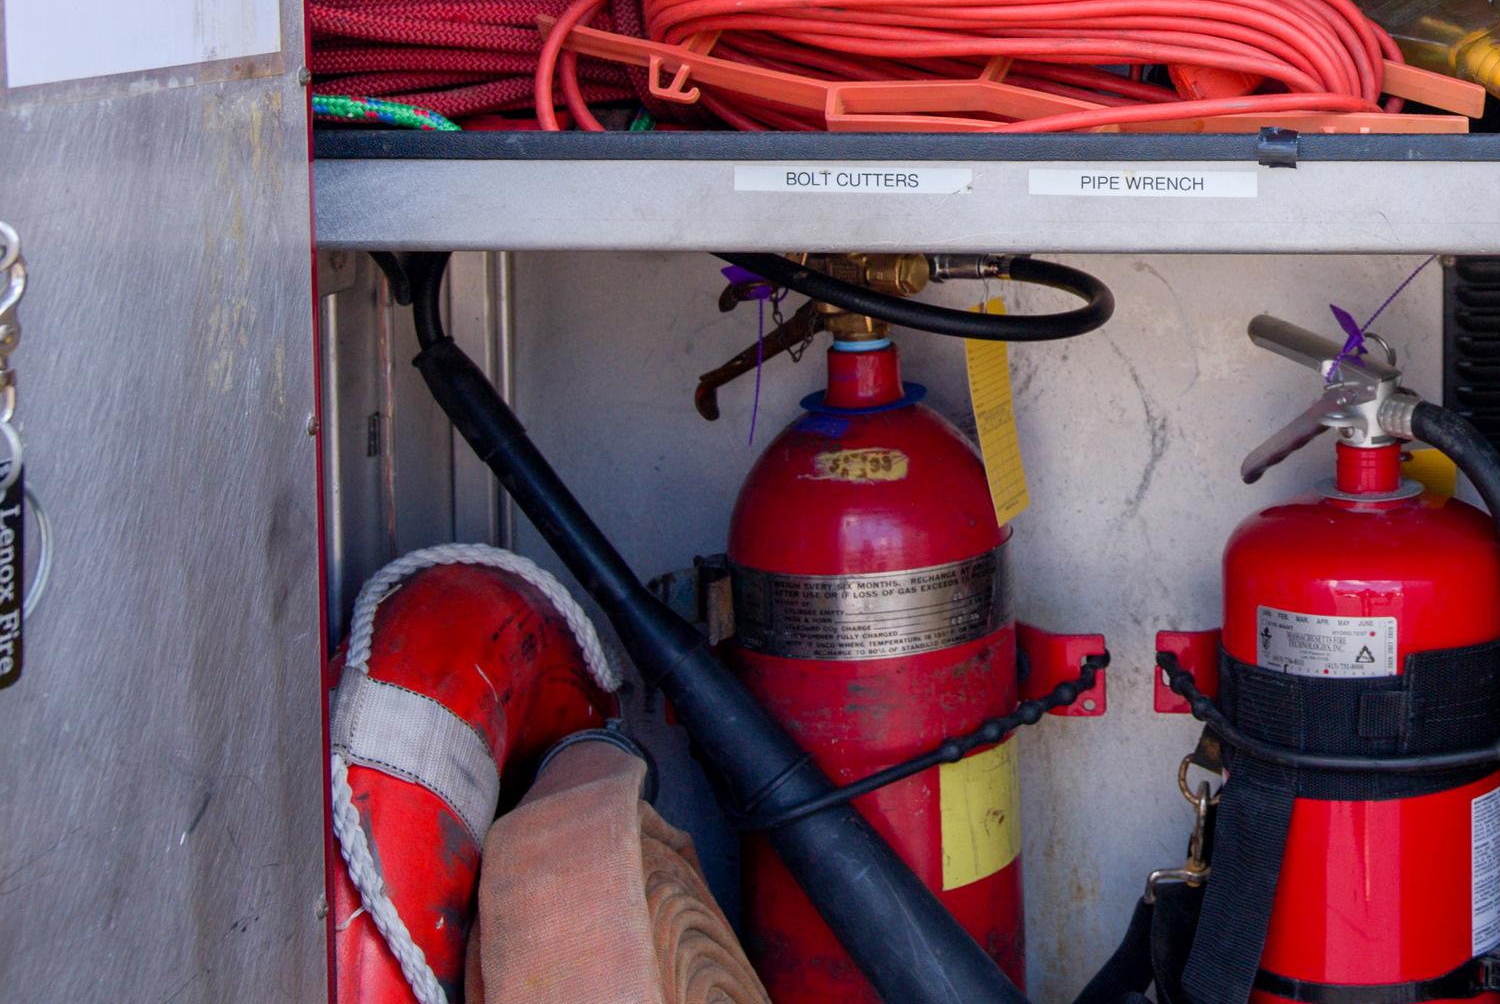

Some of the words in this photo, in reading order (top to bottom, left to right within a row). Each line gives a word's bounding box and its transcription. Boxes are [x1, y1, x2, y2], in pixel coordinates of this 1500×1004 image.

[786, 172, 830, 186] BOLT
[835, 172, 919, 188] CUTTERS
[1080, 176, 1120, 190] PIPE
[1125, 176, 1204, 191] WRENCH
[0, 504, 20, 603] Lenox
[804, 582, 832, 591] EVERY
[857, 580, 901, 589] MONTHS.
[911, 572, 957, 585] RECHARGE
[898, 587, 917, 595] GAS
[921, 579, 959, 592] EXCEEDS
[0, 609, 20, 676] Fire
[862, 631, 898, 640] CHARGED
[869, 637, 921, 646] TEMPERATURE
